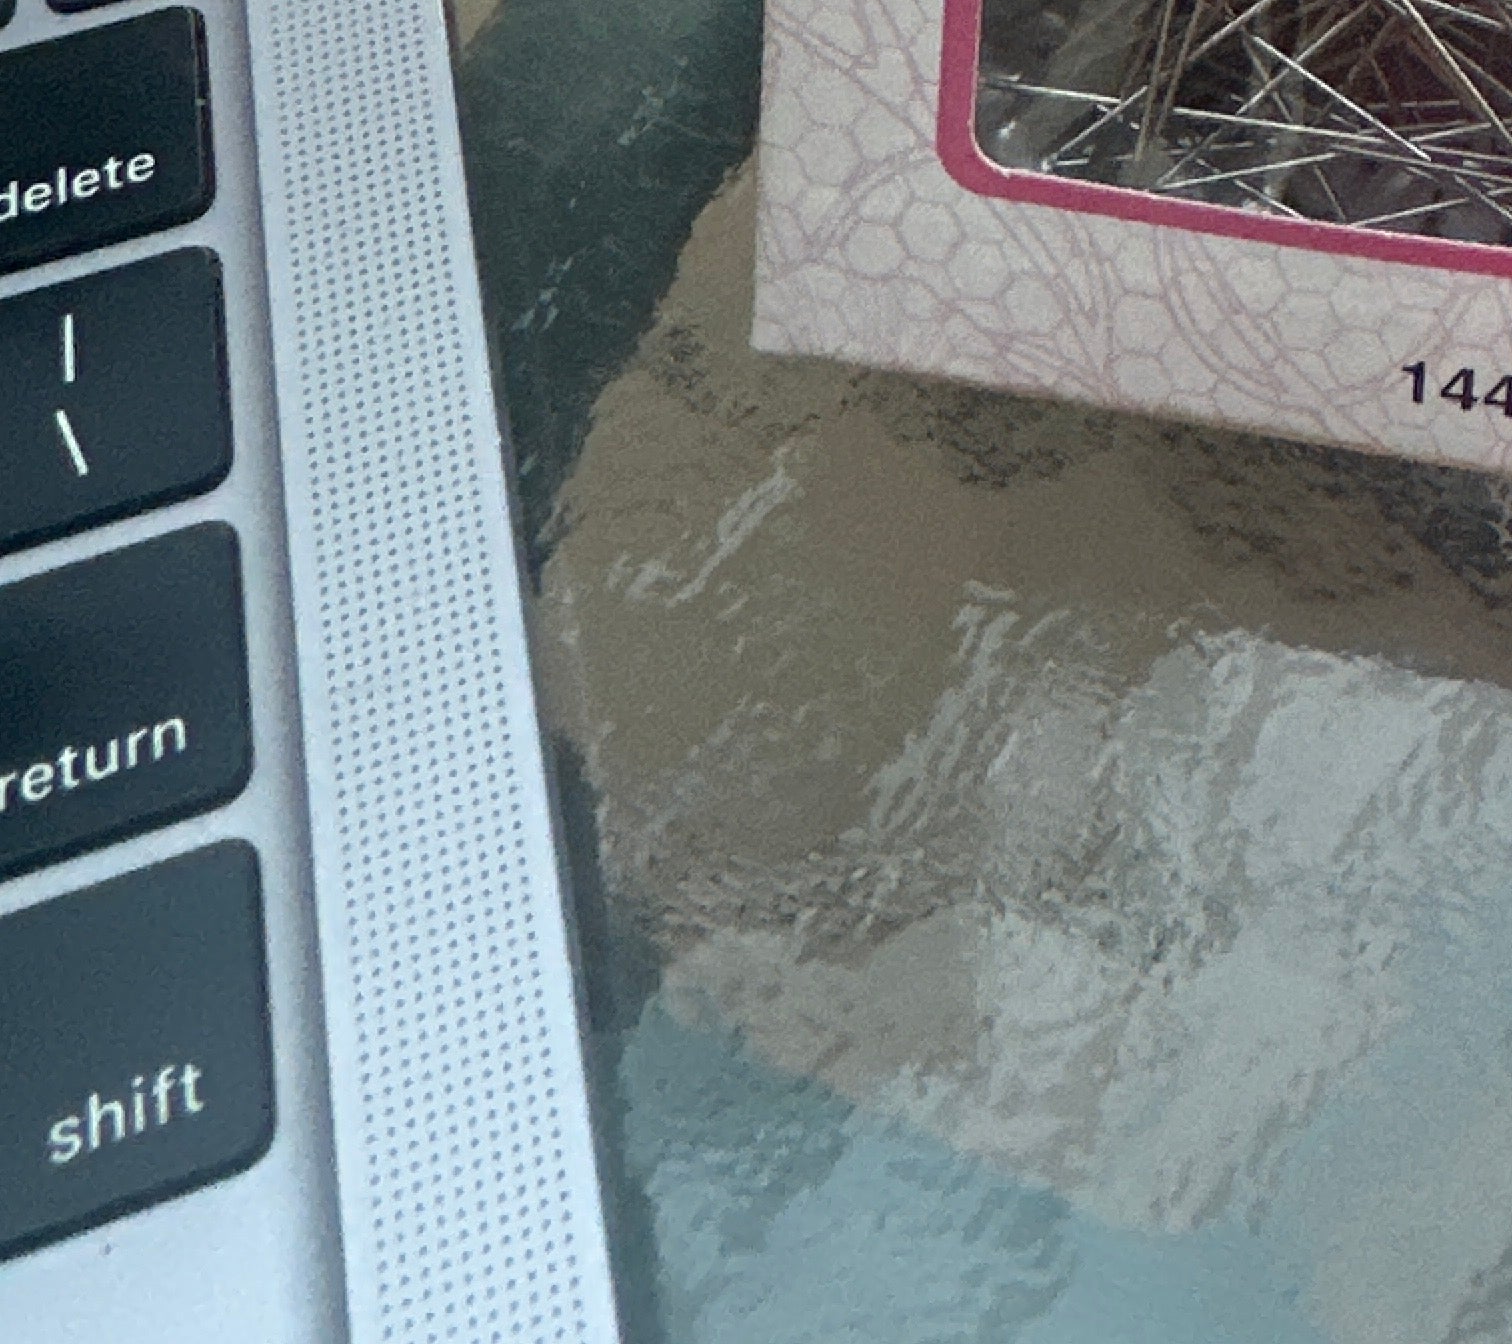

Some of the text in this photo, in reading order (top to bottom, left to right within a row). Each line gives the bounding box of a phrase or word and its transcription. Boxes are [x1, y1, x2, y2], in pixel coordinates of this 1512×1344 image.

[0, 152, 156, 221] delete
[0, 717, 187, 812] return
[47, 1060, 205, 1165] shift
